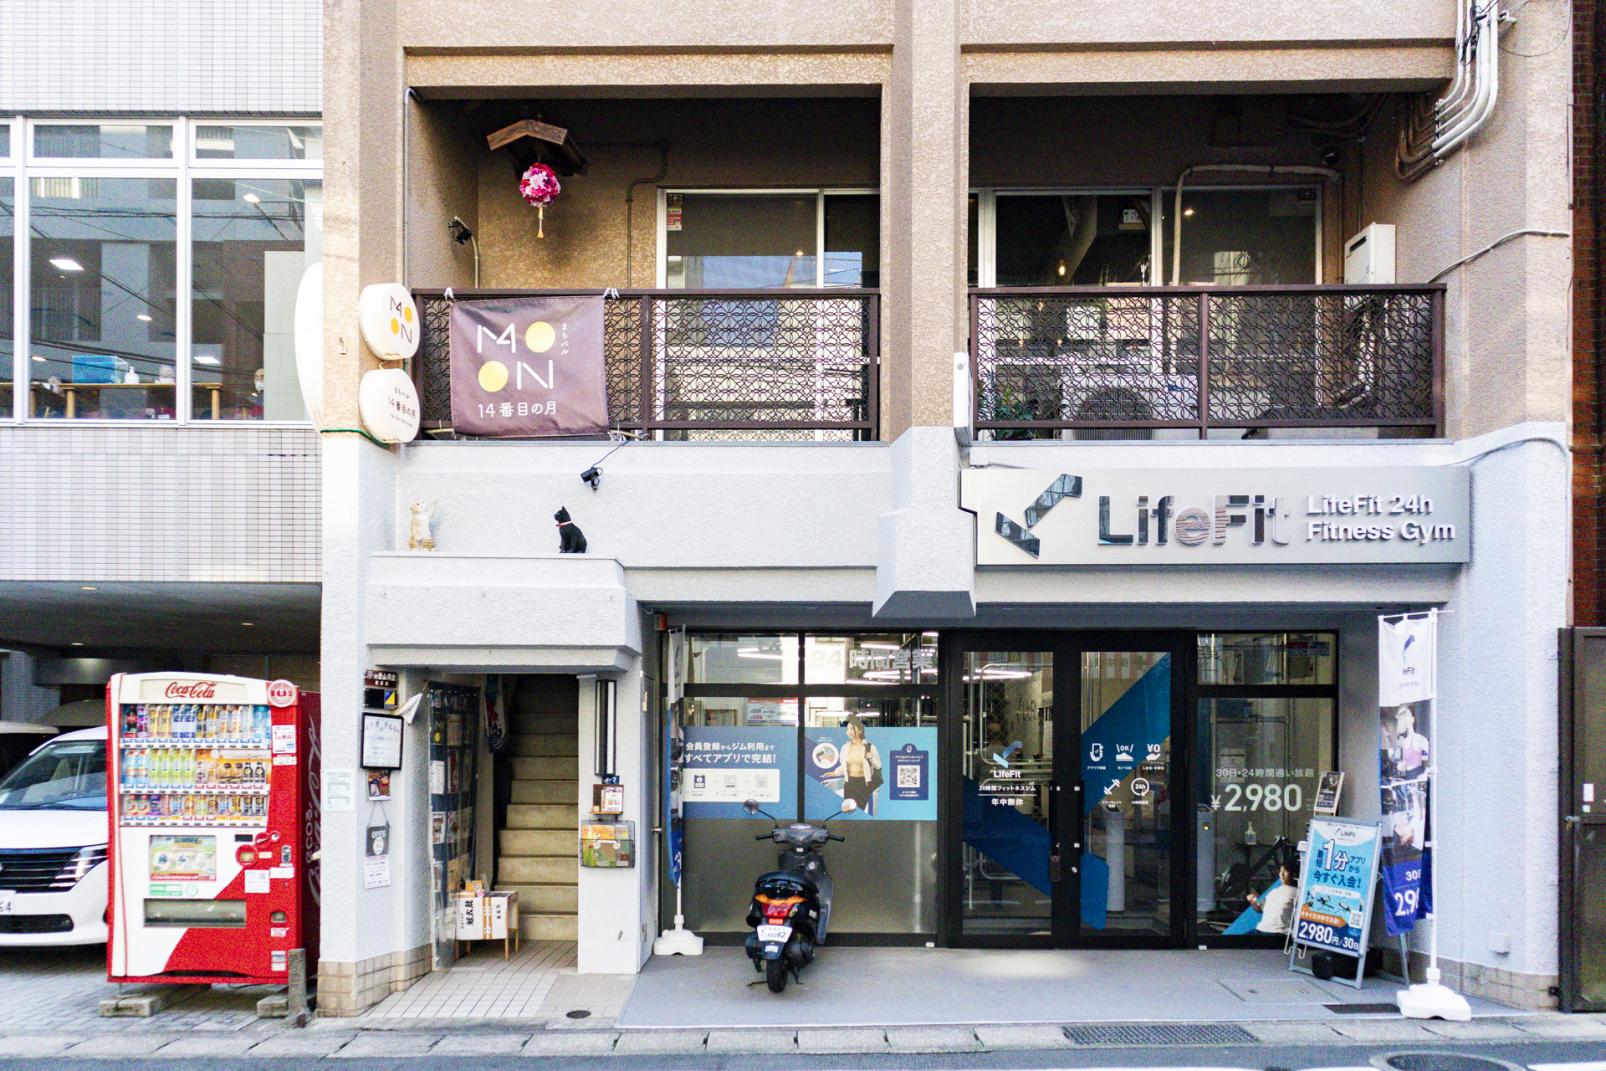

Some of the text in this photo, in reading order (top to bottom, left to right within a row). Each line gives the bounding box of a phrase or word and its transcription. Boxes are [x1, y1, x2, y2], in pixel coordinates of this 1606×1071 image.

[478, 401, 557, 418] 14番目の月
[1305, 494, 1435, 515] LifeFit 24h
[1097, 494, 1291, 547] LifeFit
[1305, 521, 1457, 545] Fitness Gym
[164, 681, 217, 698] Coca-Cola
[993, 770, 1022, 778] LifeFit
[1210, 783, 1302, 812] ¥2,980
